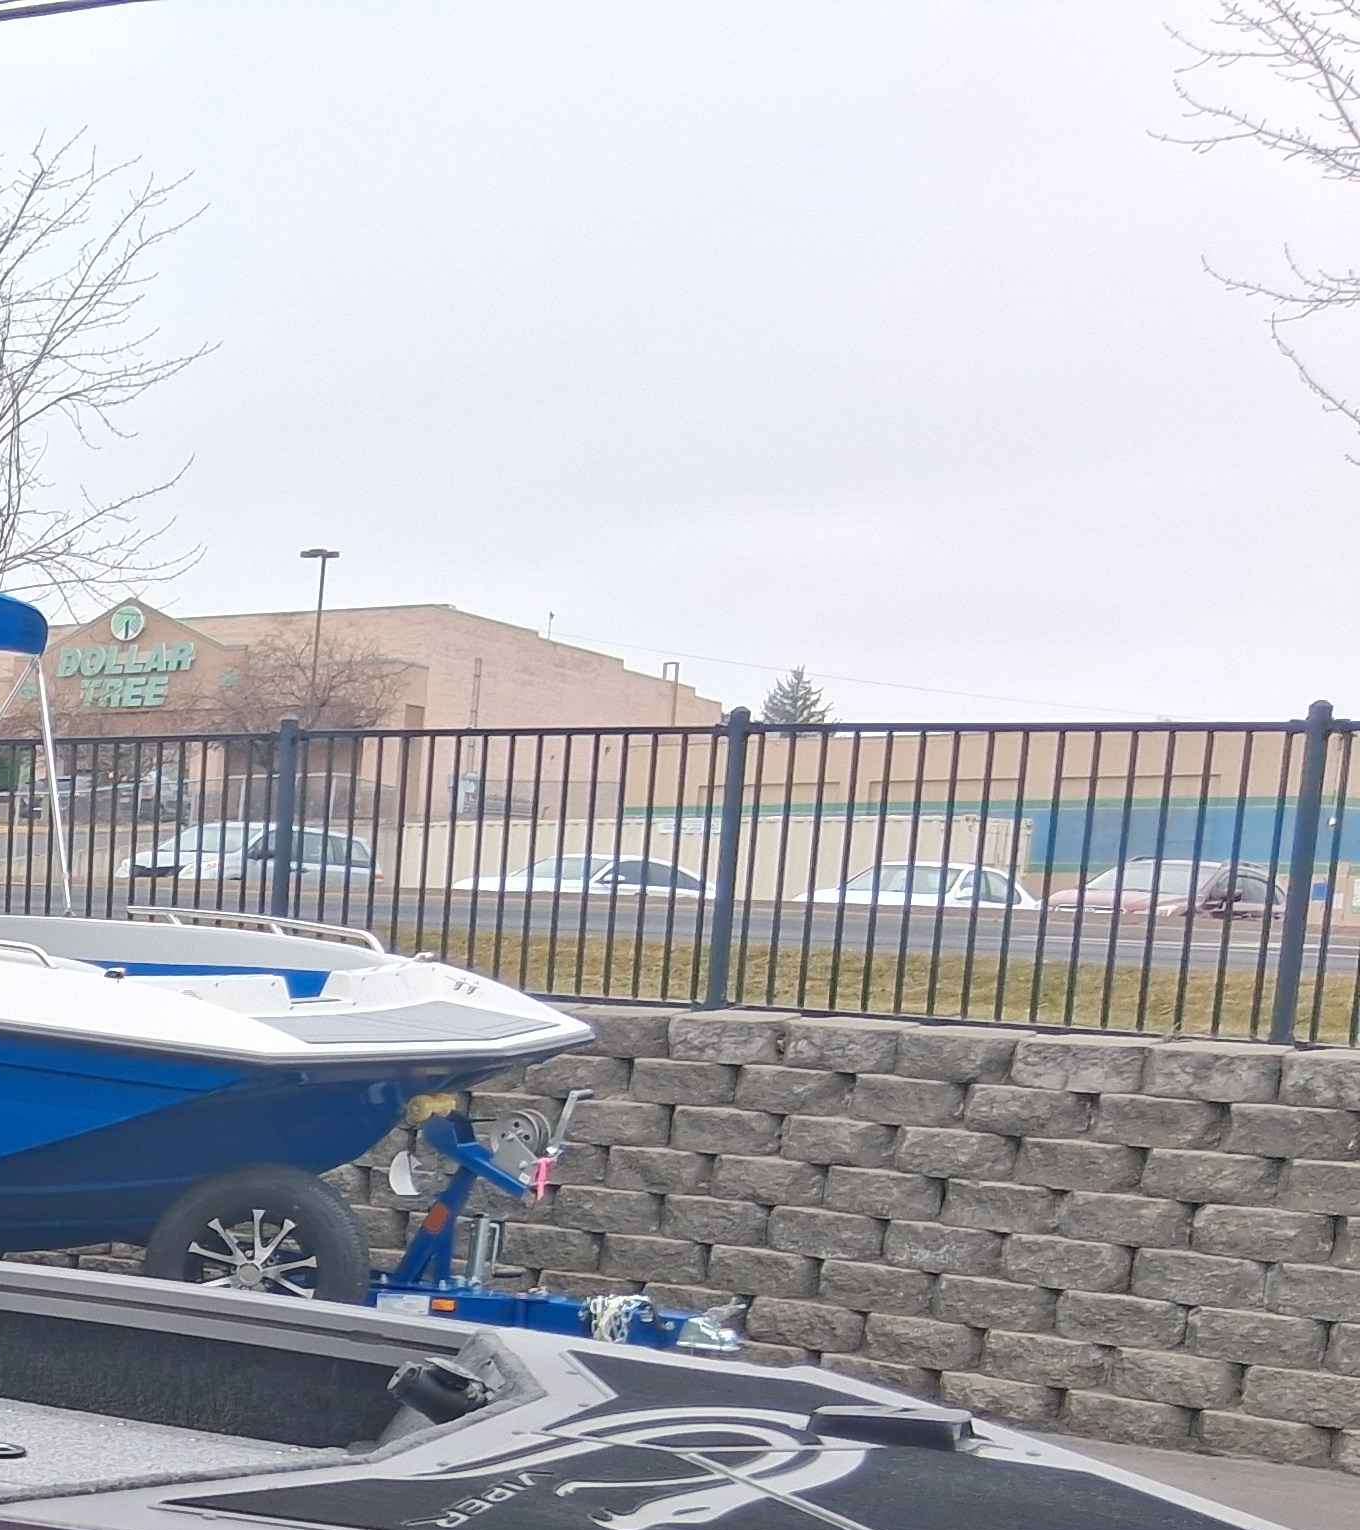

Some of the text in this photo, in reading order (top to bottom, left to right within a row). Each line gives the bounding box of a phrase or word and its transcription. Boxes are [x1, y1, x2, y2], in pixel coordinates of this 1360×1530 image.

[56, 641, 197, 708] DOLLAR TREE
[402, 1470, 555, 1529] VIPER
